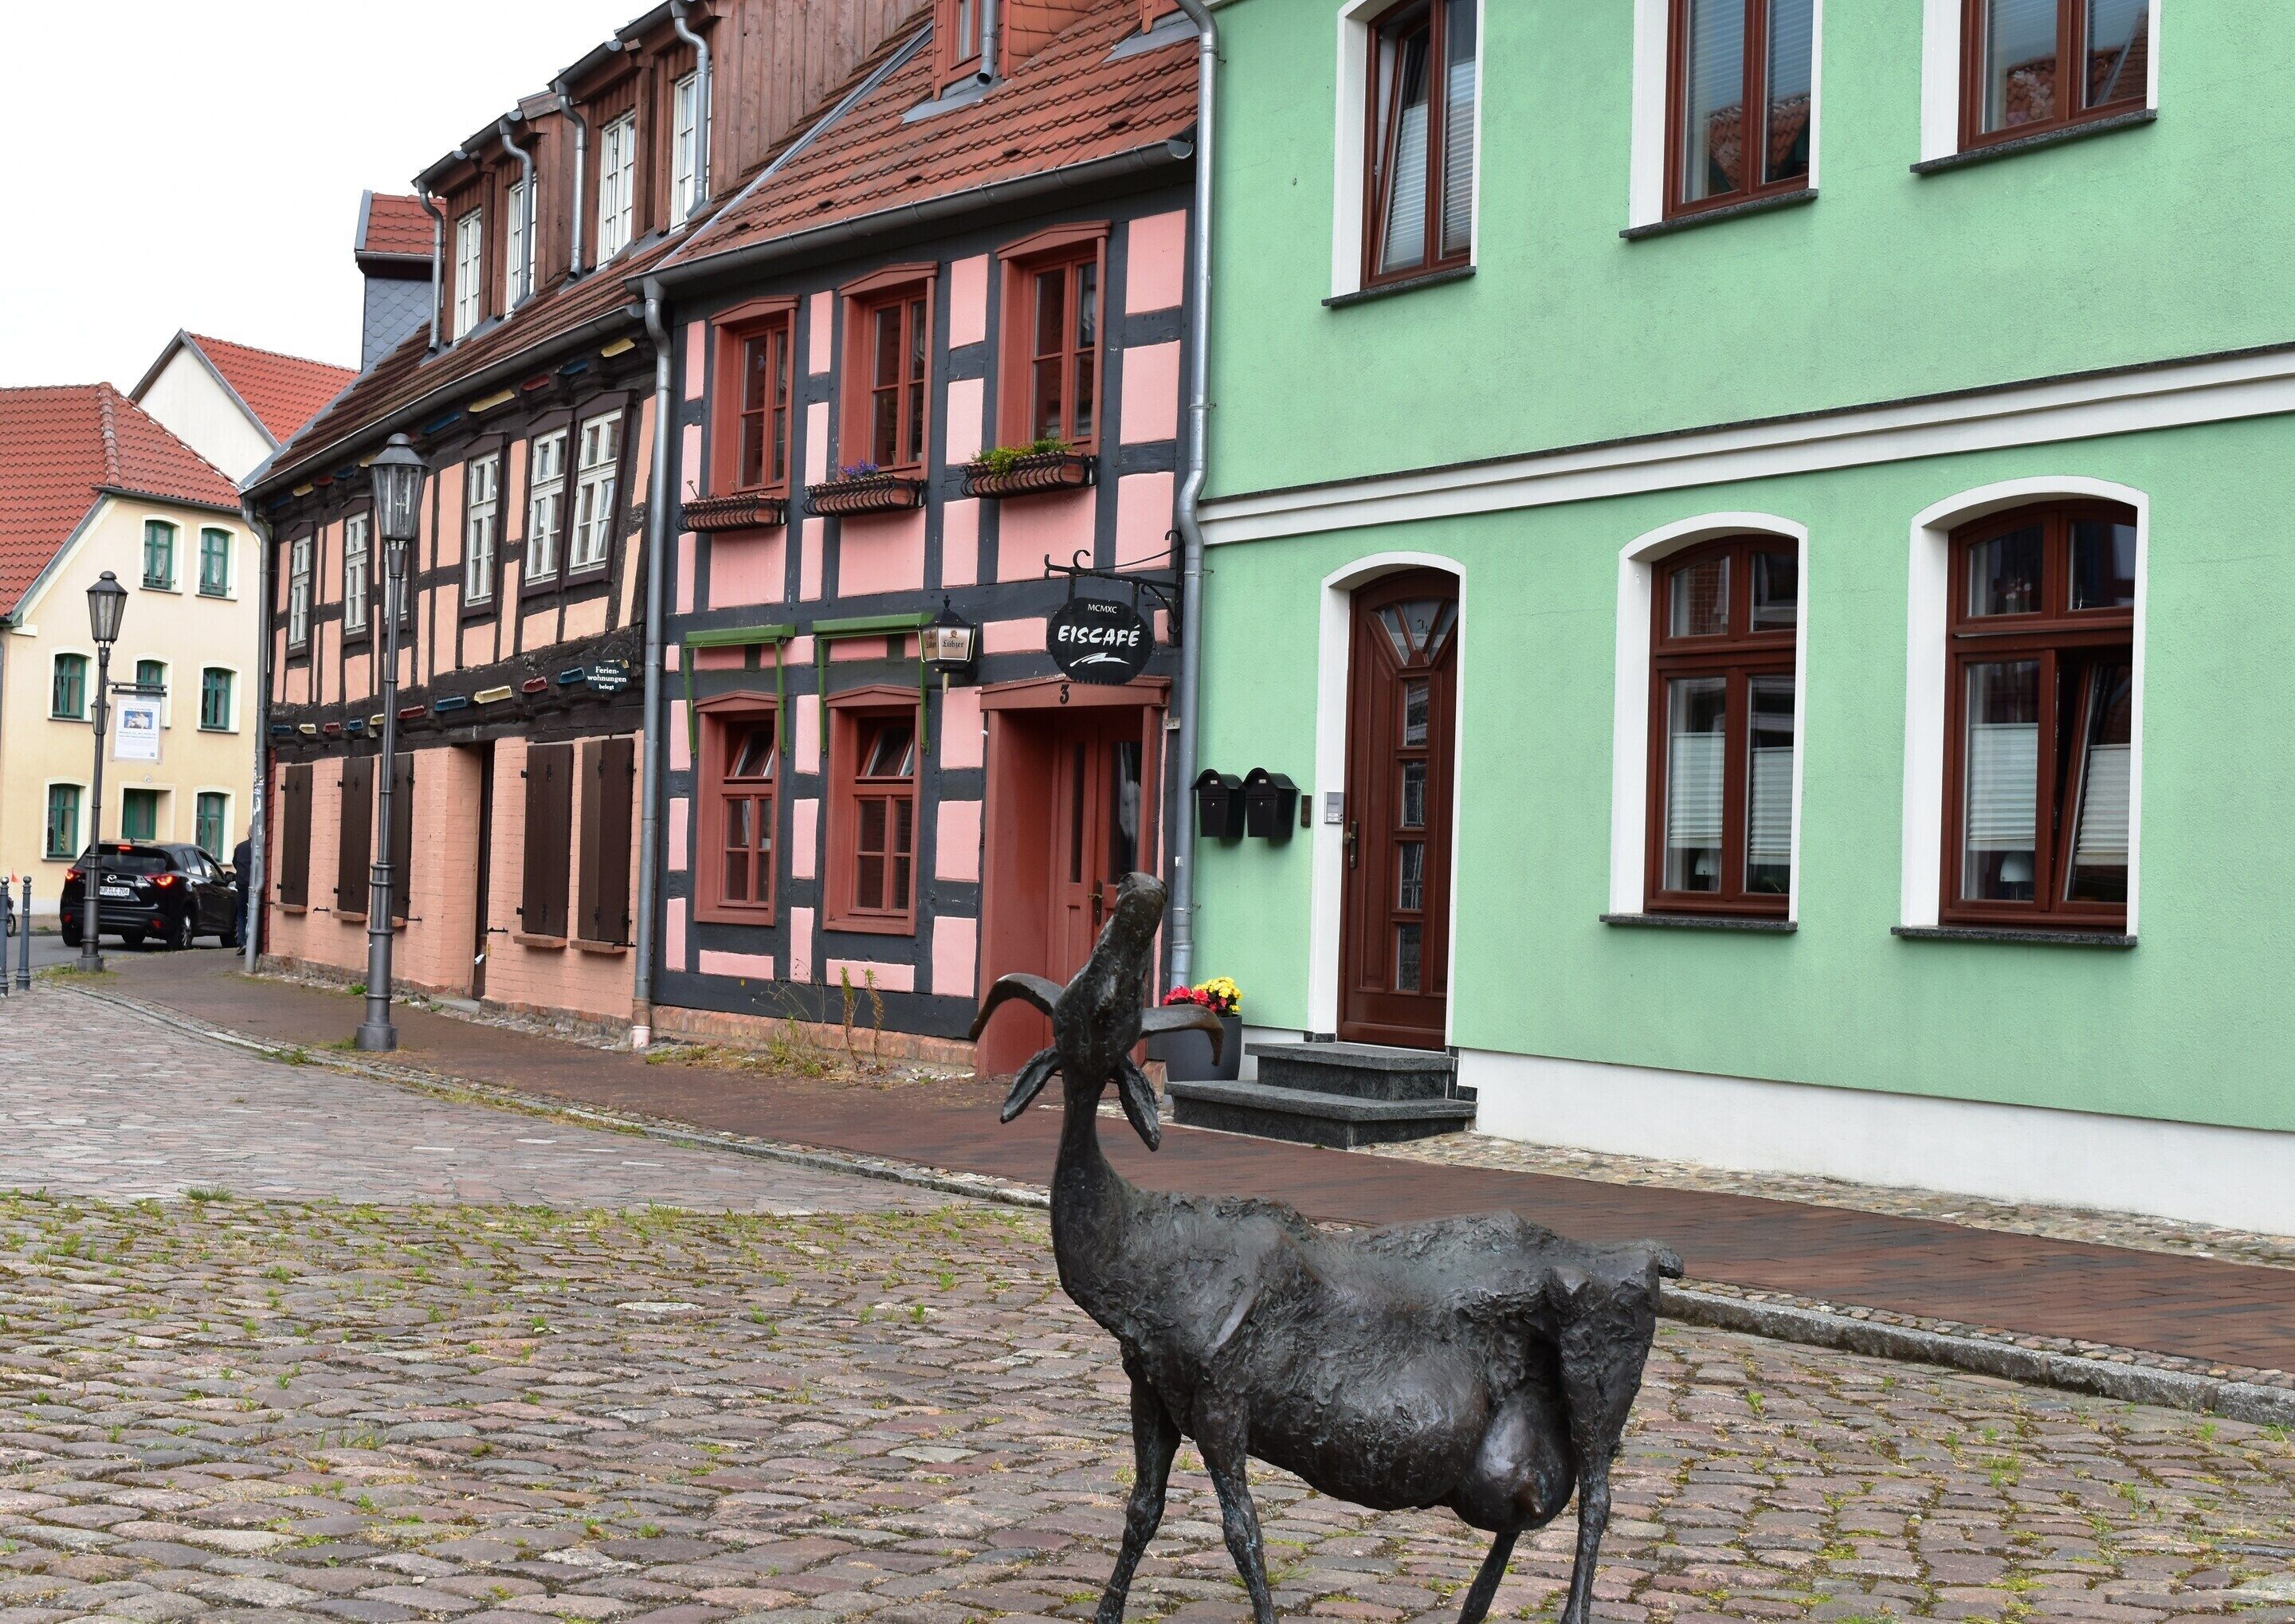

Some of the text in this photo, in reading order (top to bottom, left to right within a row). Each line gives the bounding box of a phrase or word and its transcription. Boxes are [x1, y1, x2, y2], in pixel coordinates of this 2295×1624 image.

[1087, 604, 1117, 614] MCMXC
[1057, 624, 1140, 647] EISCAFÉ
[942, 639, 964, 648] Lübzer
[595, 665, 619, 674] Ferien-
[587, 674, 627, 683] wohnungen
[1060, 684, 1069, 704] 3
